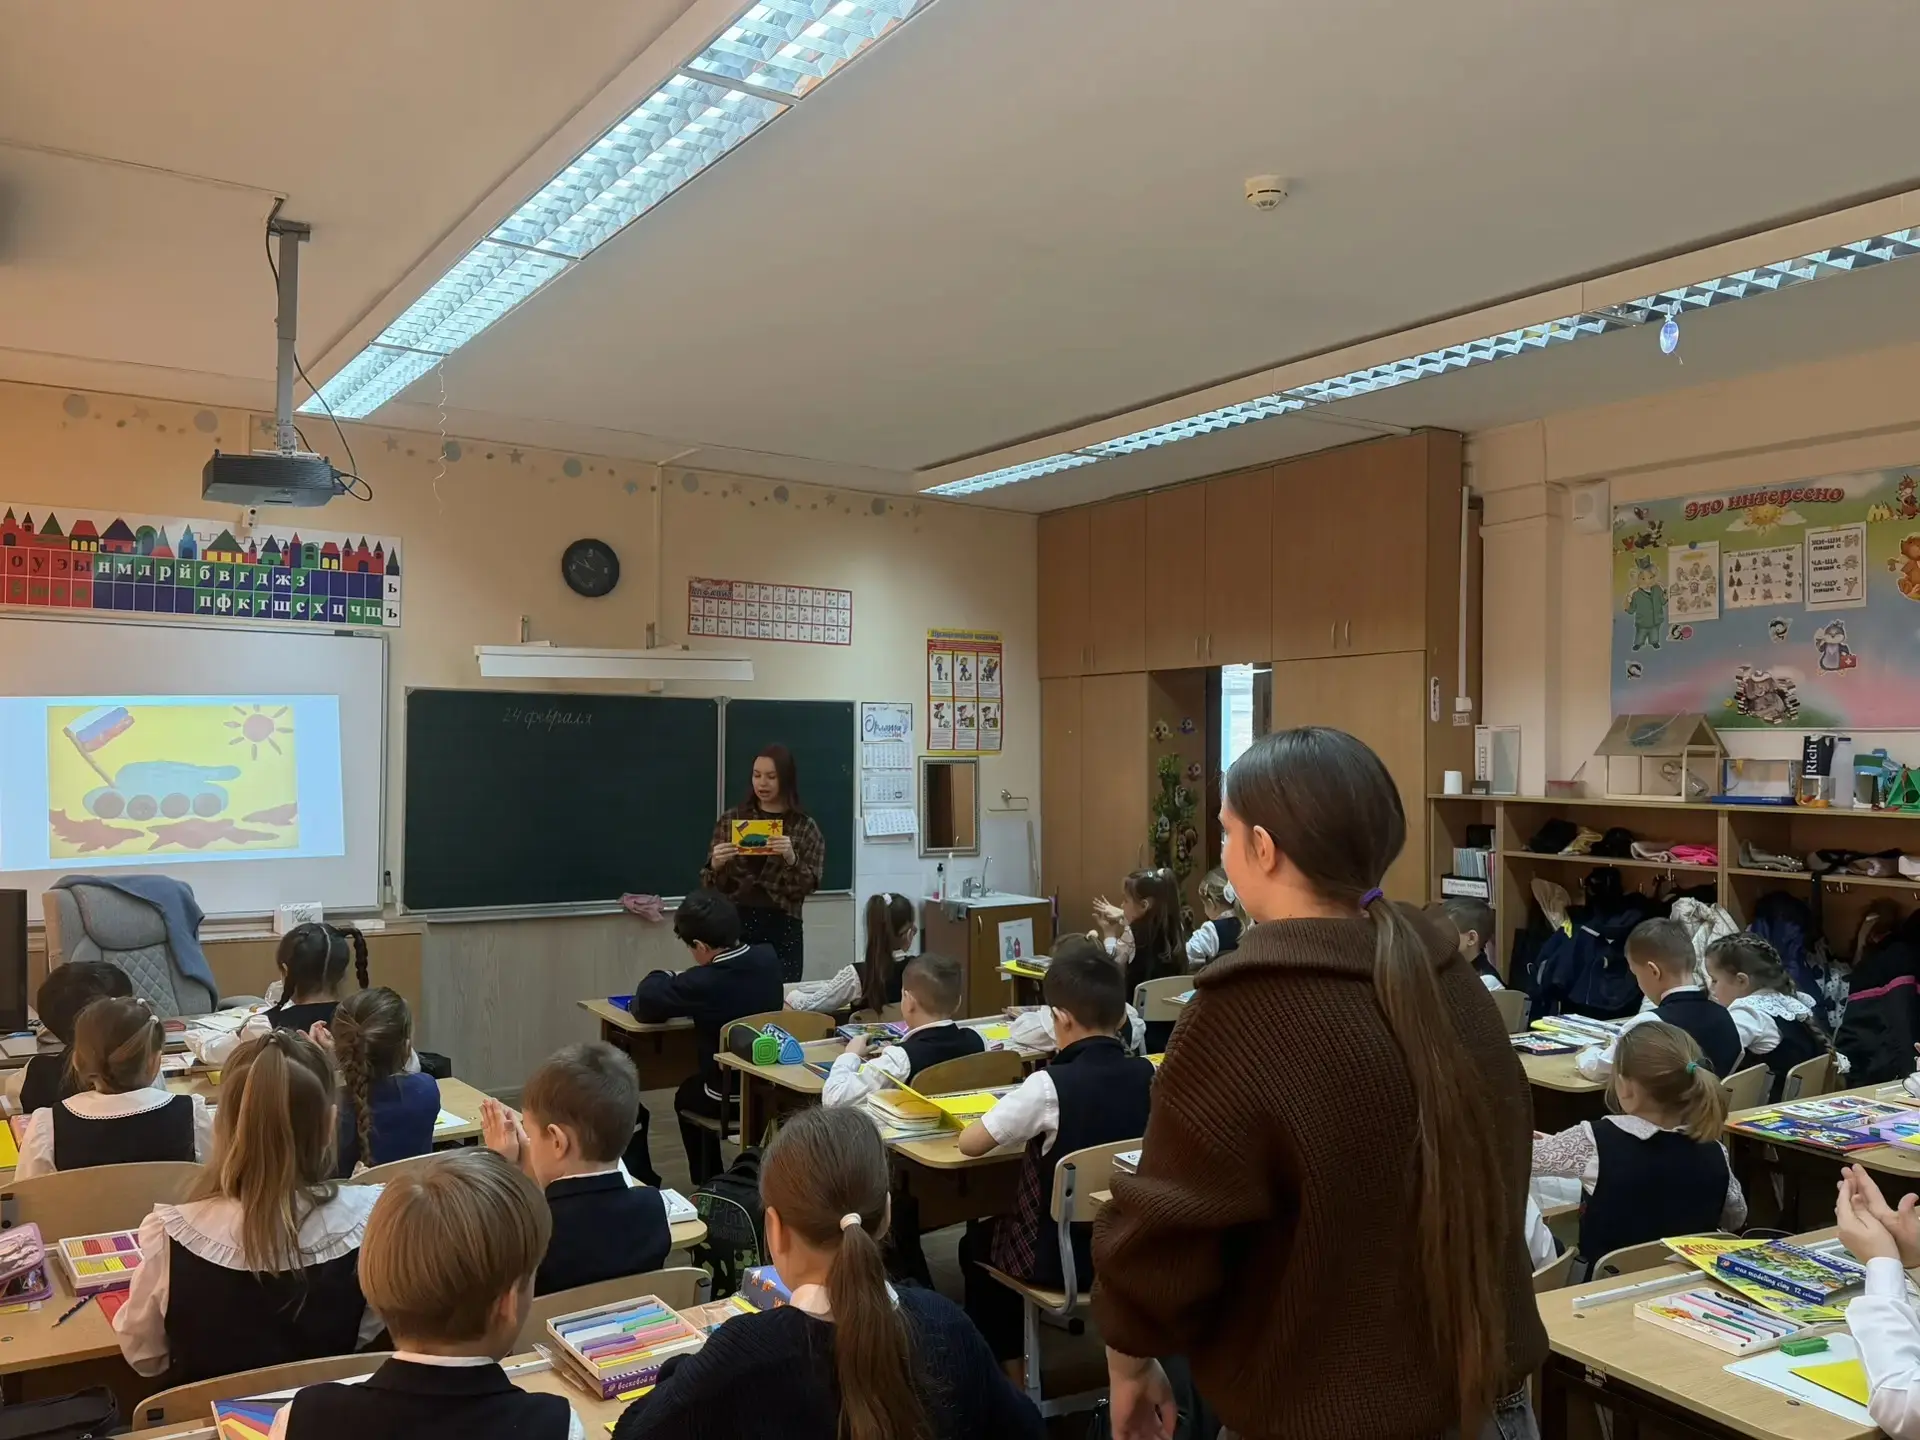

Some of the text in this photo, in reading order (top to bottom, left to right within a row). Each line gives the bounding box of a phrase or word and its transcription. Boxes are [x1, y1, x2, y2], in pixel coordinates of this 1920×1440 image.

[1685, 488, 1845, 520] Это интересно
[12, 555, 305, 587] о у э ы н м л р й б в г д ж з
[388, 583, 397, 593] ь
[199, 593, 398, 620] п ф к т ш с х ц ч щ ъ
[502, 707, 592, 732] 24 февраля
[1806, 743, 1817, 773] Rich
[1748, 1271, 1776, 1286] modelling
[1777, 1280, 1790, 1291] clay
